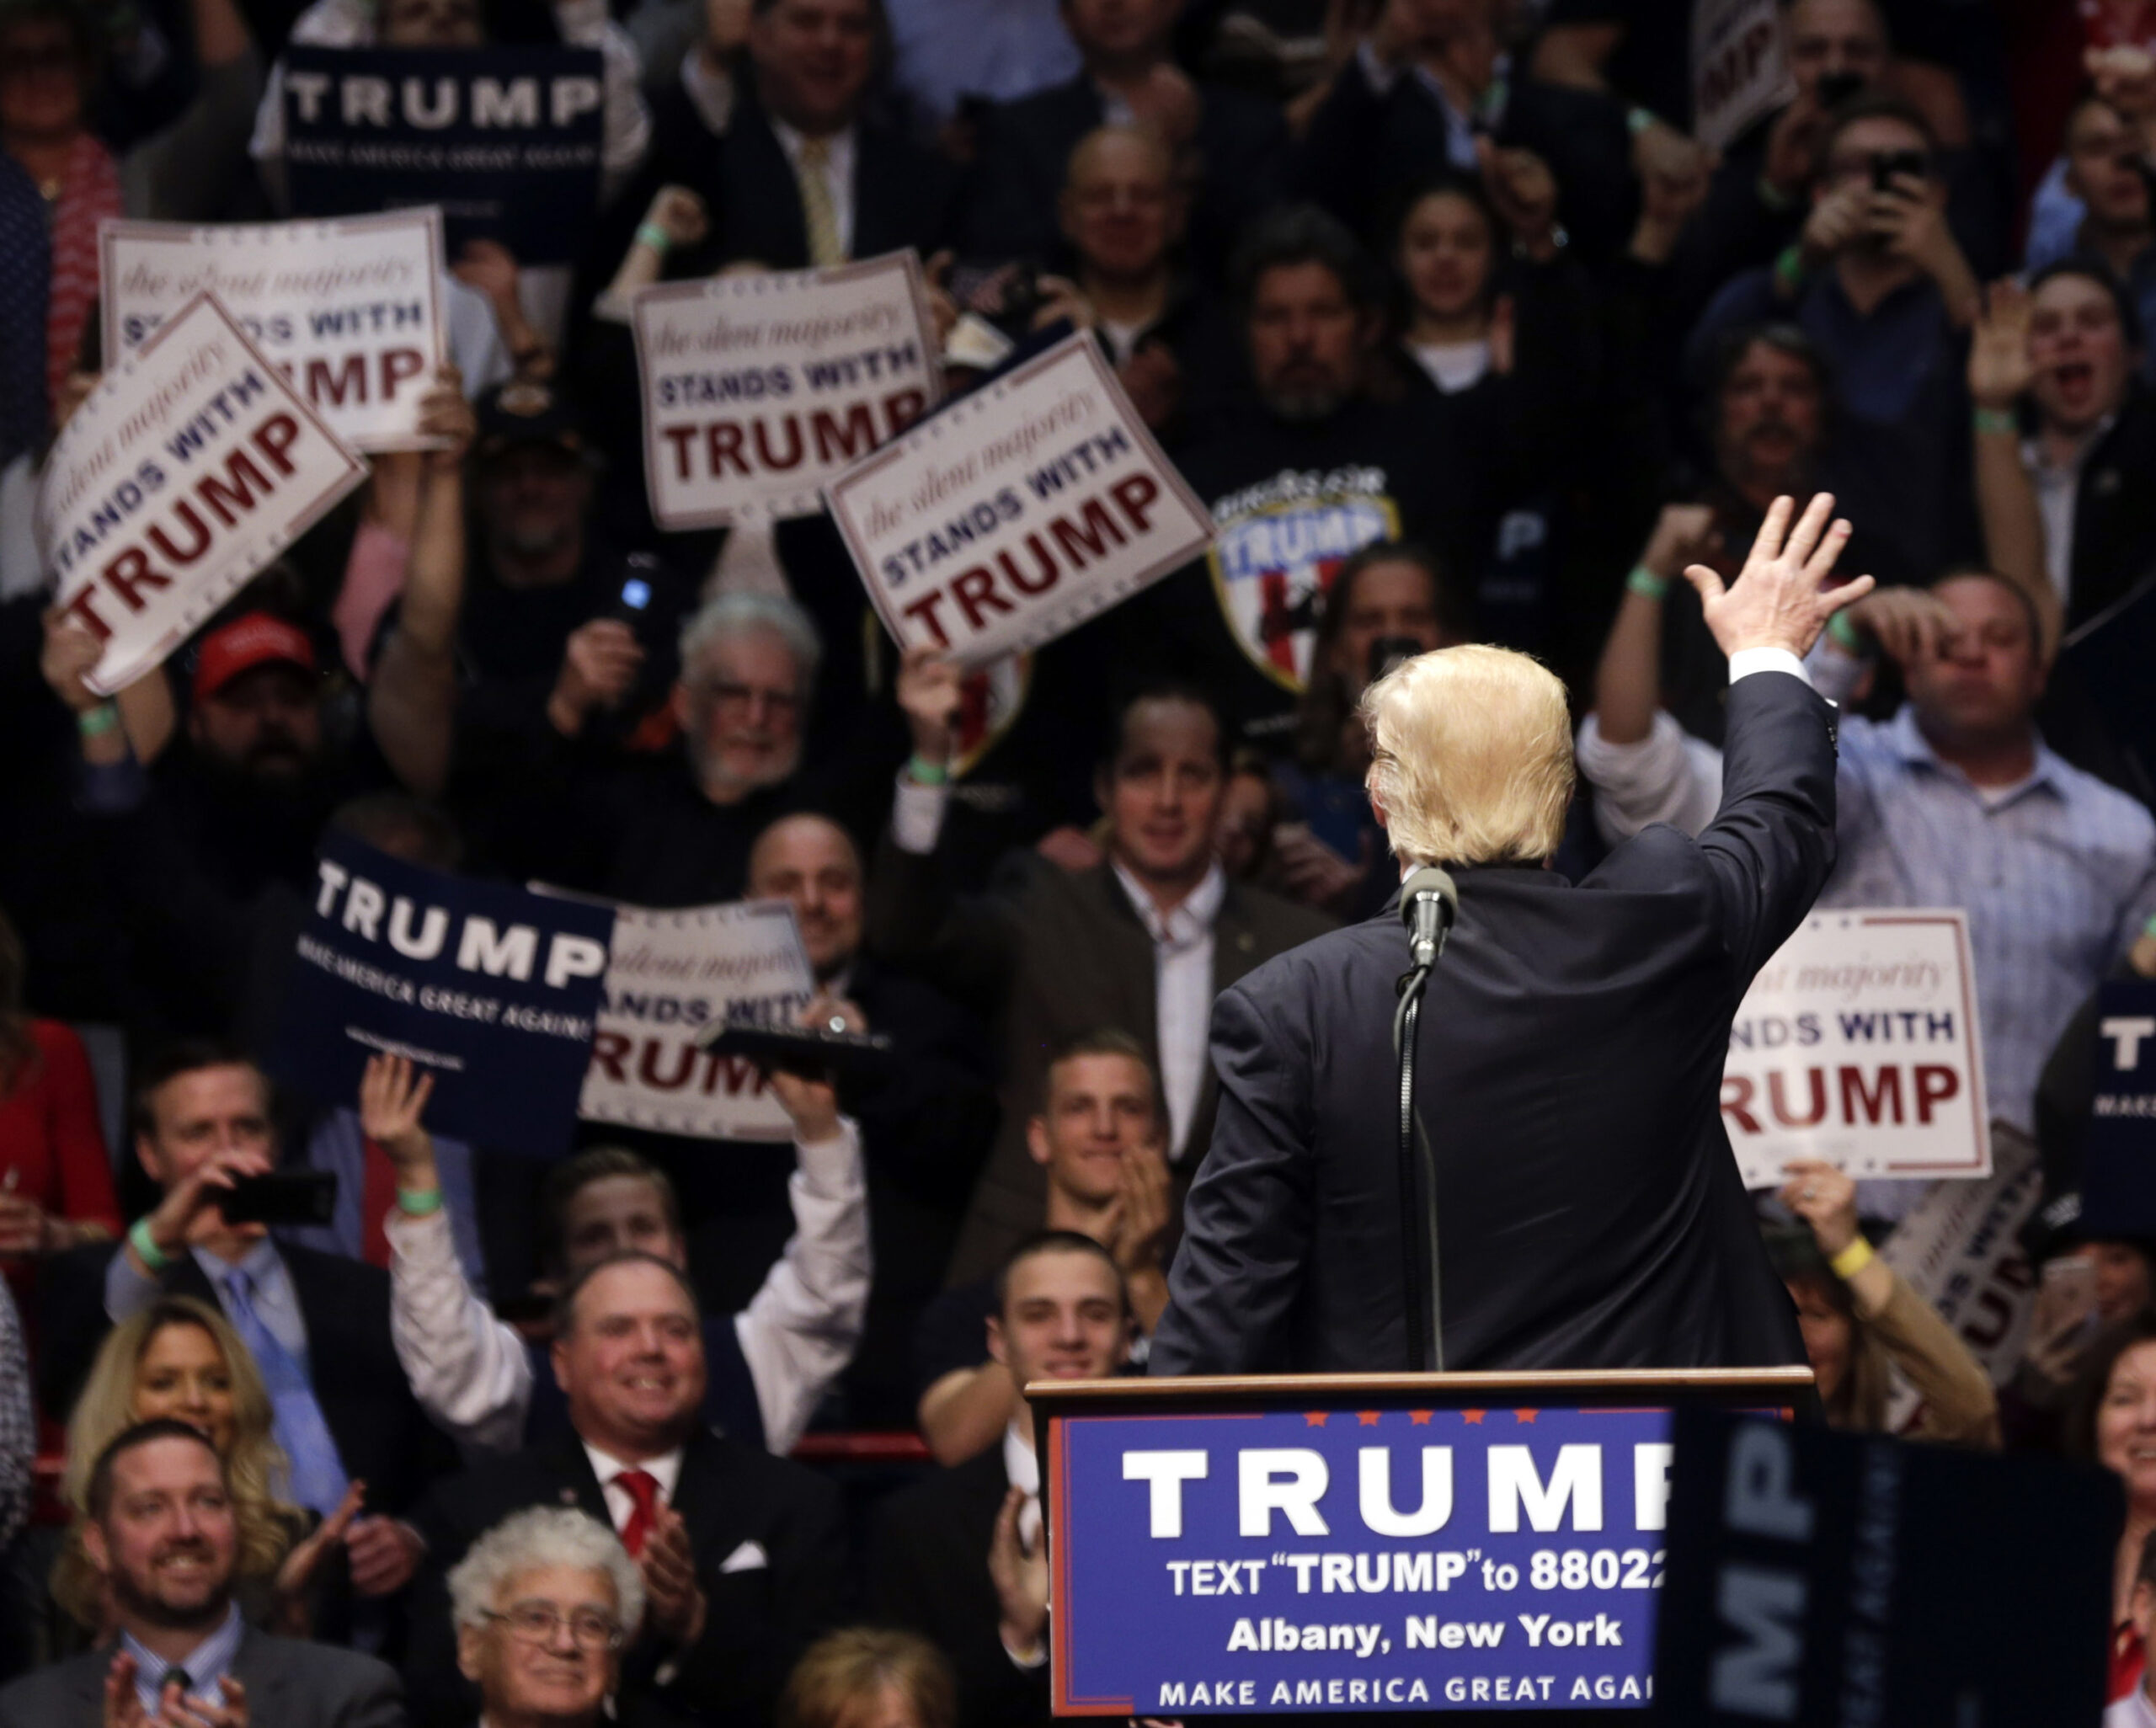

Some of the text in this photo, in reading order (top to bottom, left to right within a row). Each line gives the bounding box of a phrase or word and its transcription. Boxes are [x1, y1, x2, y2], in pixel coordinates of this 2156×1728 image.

[286, 72, 601, 130] TRUMP
[272, 257, 415, 296] majority
[309, 300, 422, 339] WITH
[659, 339, 917, 408] STANDS WITH
[661, 386, 927, 482] TRUMP
[982, 387, 1097, 472] majority
[56, 369, 266, 578] TANDS WITH
[881, 424, 1133, 588] STANDS WITH
[62, 410, 300, 644] TRUMP
[902, 471, 1162, 651] TRUMP
[315, 858, 606, 990] TRUMP
[419, 984, 503, 1024] GREAT
[1796, 956, 1944, 1002] majority
[1729, 1011, 1955, 1048] NDS WITH
[592, 1031, 769, 1100] RUM
[1719, 1064, 1960, 1135] RUMP
[1166, 1560, 1267, 1596] TEXT
[1481, 1557, 1518, 1591] to
[1226, 1613, 1624, 1658] Albany, New York
[1159, 1675, 1653, 1707] MAKE AMERICA GREAT AGAI
